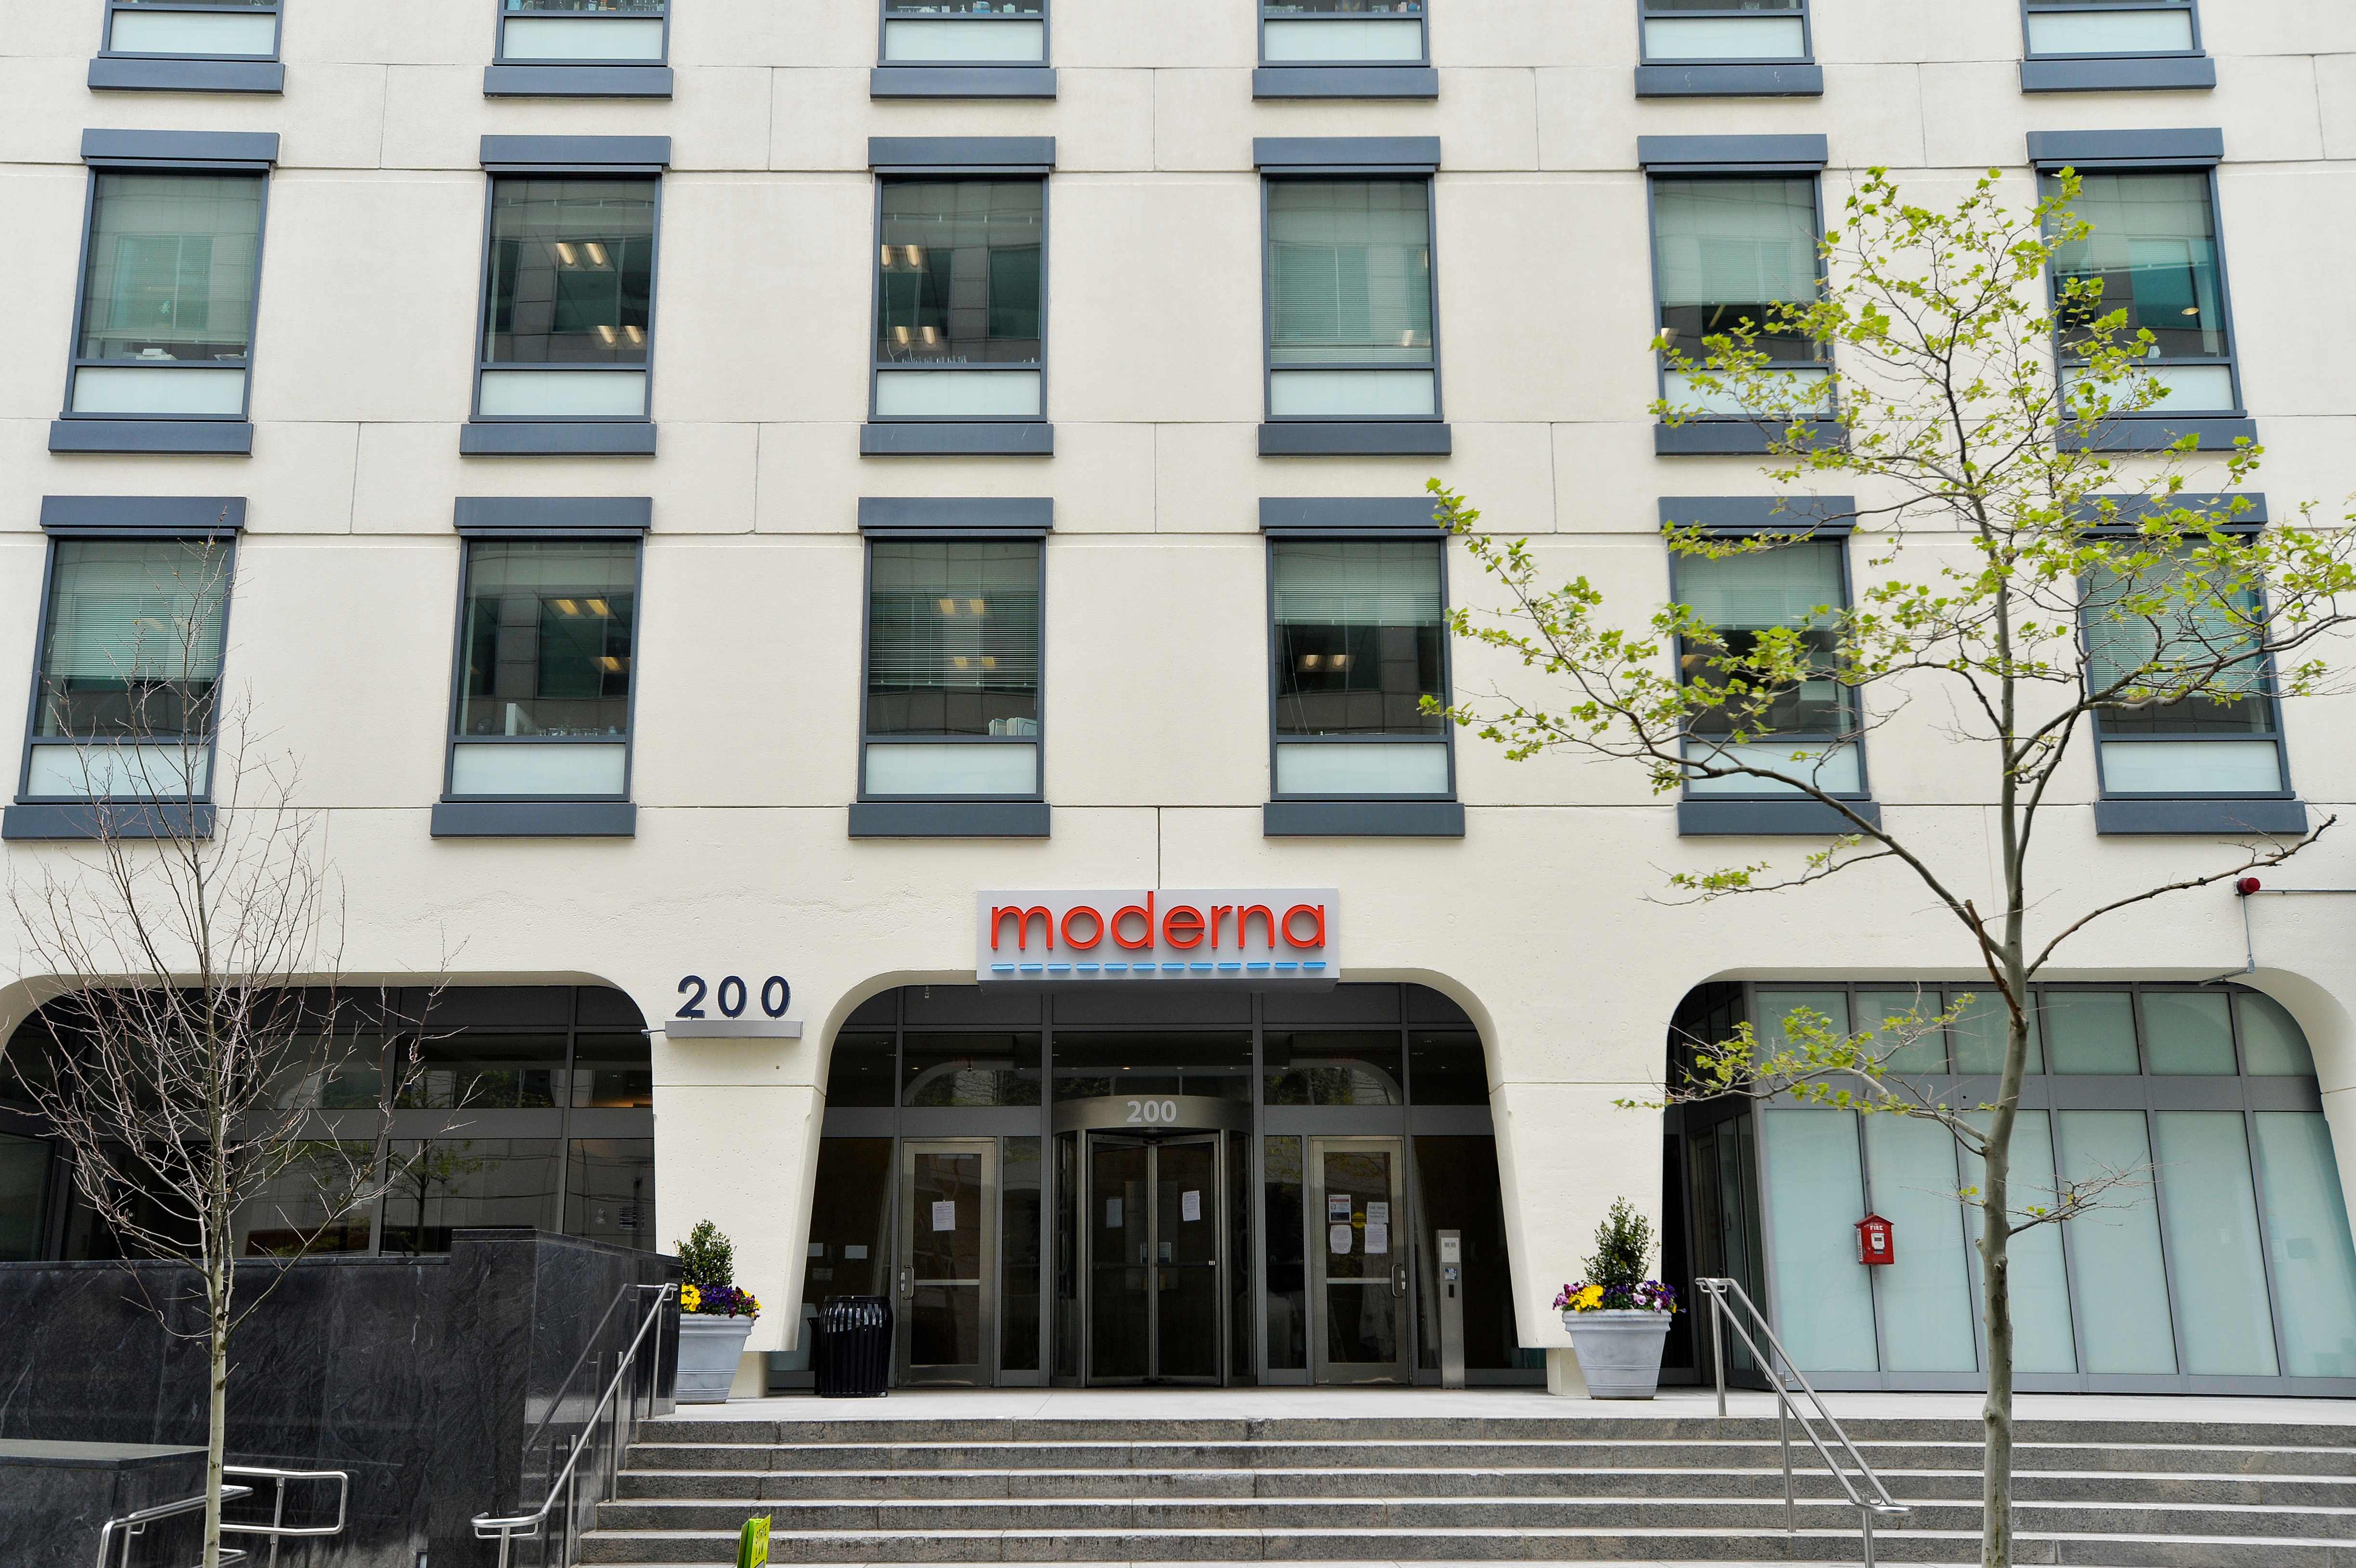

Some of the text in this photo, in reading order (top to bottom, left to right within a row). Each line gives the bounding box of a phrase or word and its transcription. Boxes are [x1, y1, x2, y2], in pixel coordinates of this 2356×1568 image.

[991, 891, 1325, 949] moderna
[675, 975, 790, 1018] 200
[1126, 1100, 1177, 1123] 200
[755, 1523, 767, 1544] STATE
